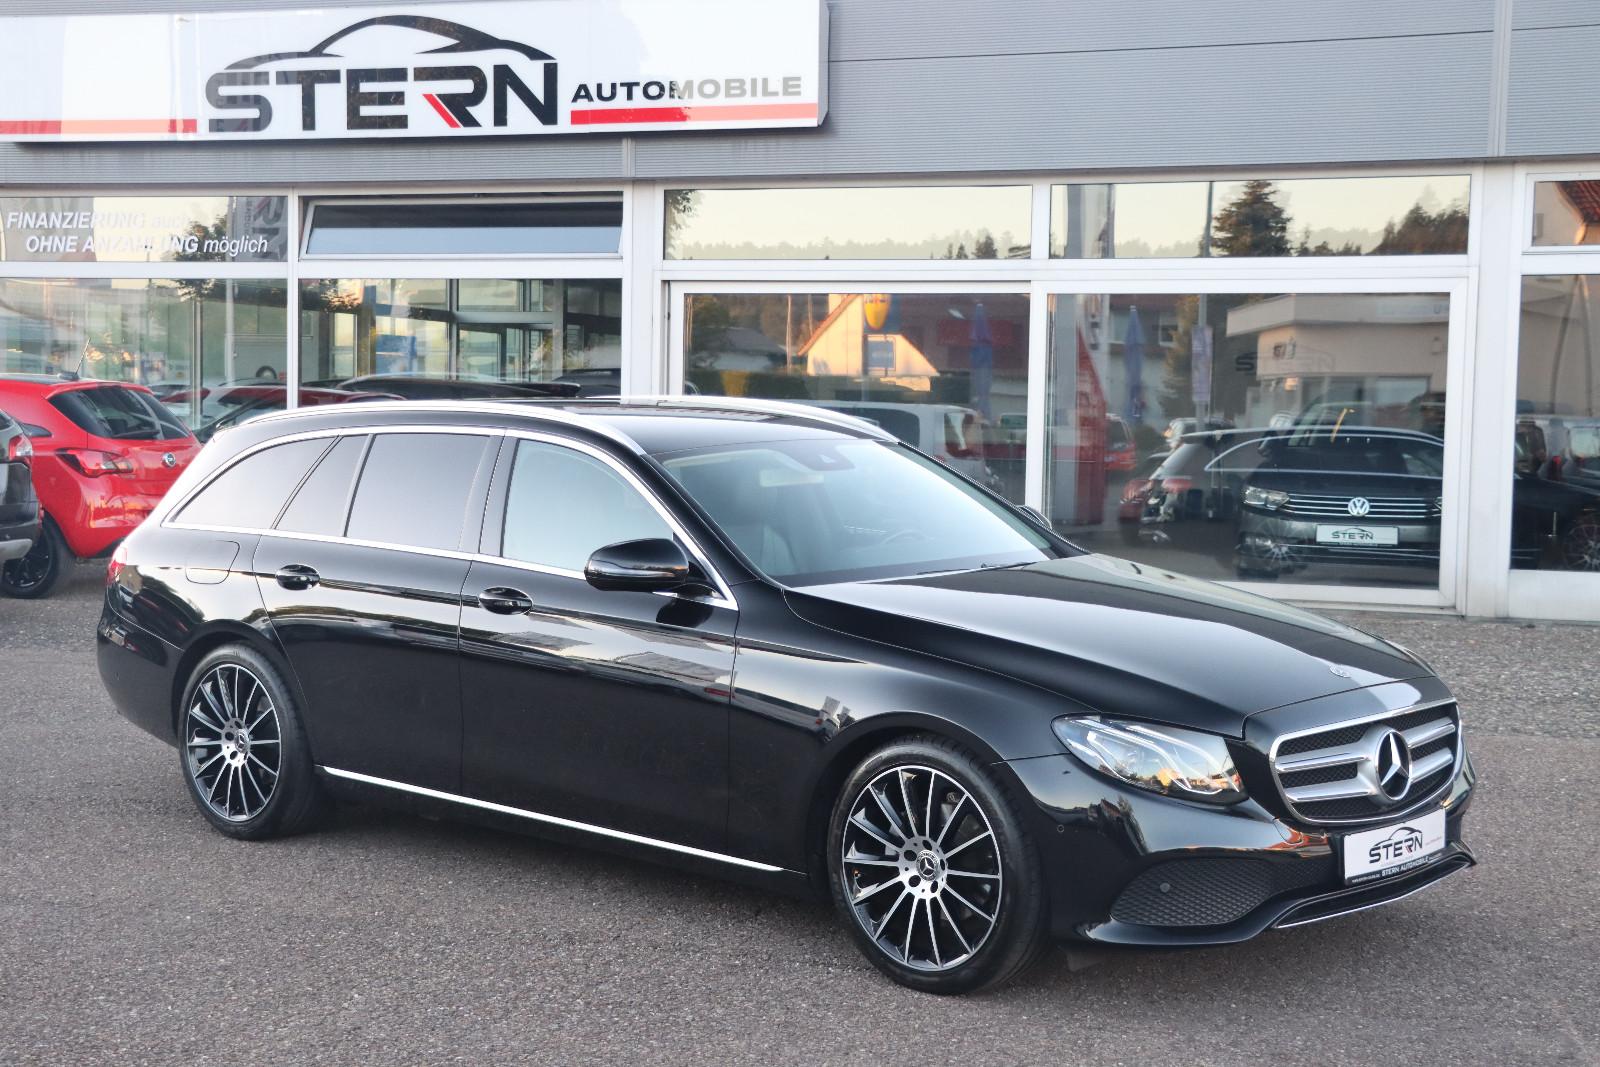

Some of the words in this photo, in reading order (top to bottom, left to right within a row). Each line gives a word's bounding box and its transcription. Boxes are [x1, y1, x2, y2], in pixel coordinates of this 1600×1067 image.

[206, 60, 558, 133] STERN
[571, 77, 803, 103] AUTOMOBILE
[7, 212, 144, 229] FINANZIERUNG
[26, 236, 77, 253] OHNE
[204, 235, 268, 258] möglich
[1331, 532, 1374, 540] STERN
[1369, 833, 1423, 864] STERN
[1381, 866, 1400, 877] STERN
